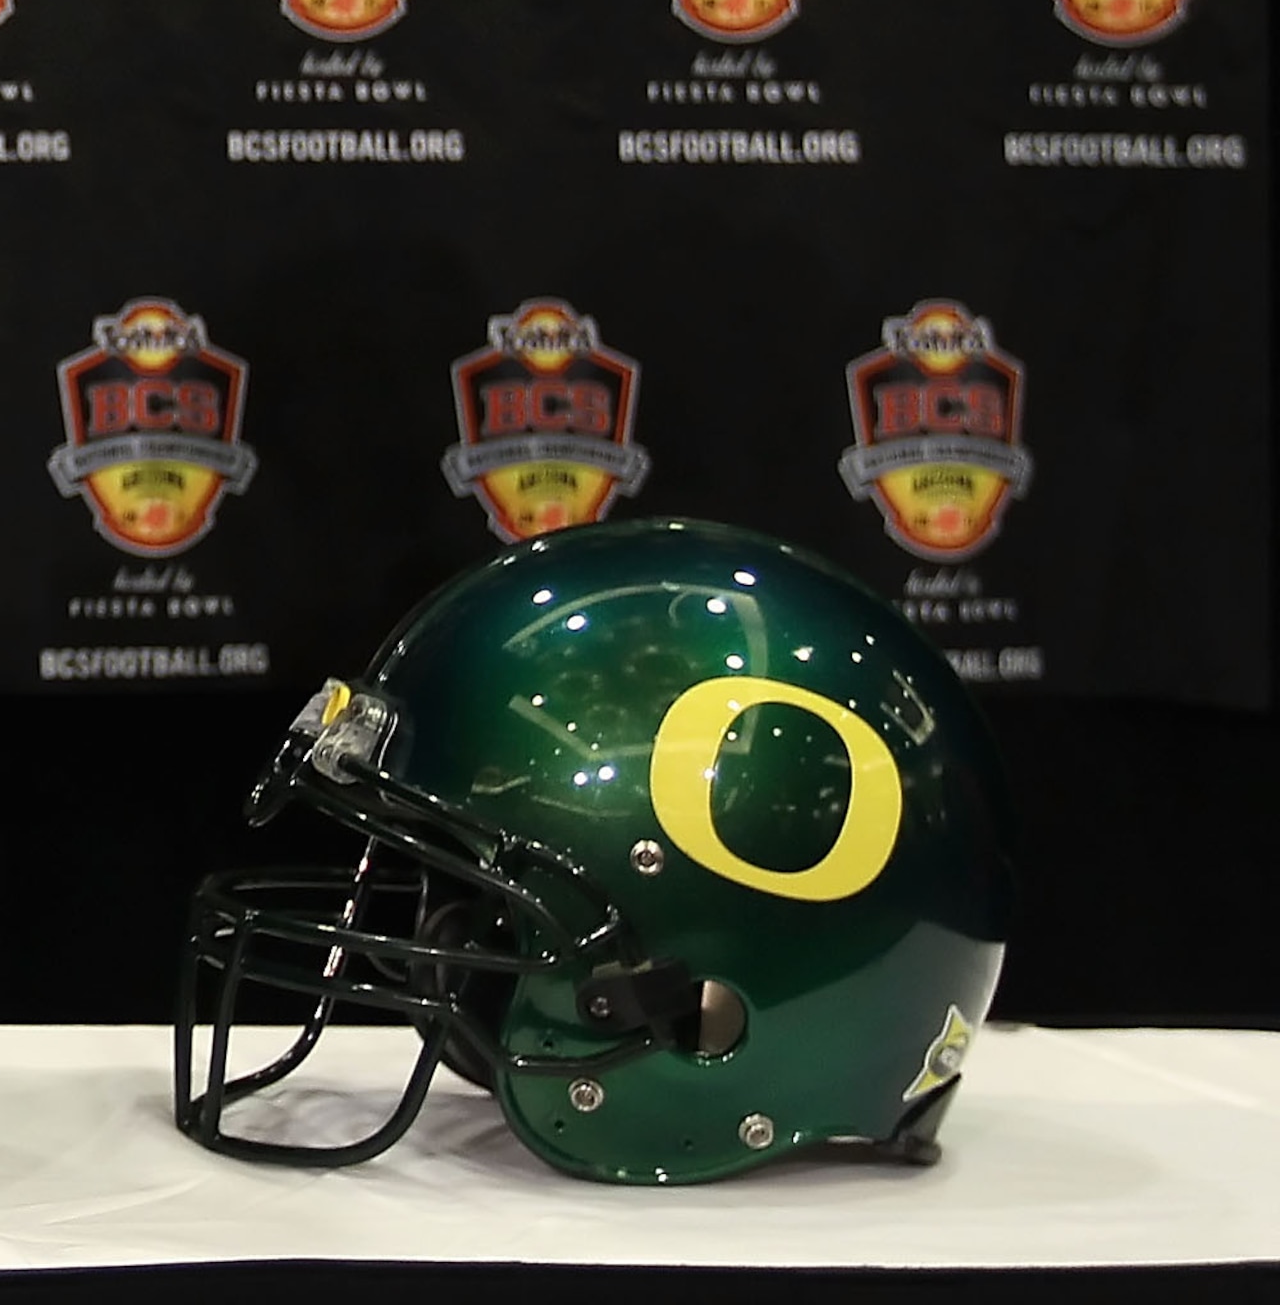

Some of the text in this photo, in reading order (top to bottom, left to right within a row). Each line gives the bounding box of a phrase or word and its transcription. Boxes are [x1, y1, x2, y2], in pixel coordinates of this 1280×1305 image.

[354, 80, 426, 103] BOWL
[226, 129, 466, 162] BCSFOOTBALL.ORG
[618, 129, 861, 164] BCSFOOTBALL.ORG
[1003, 133, 1246, 167] BCSFOOTBALL.ORG
[90, 378, 220, 435] BCS
[485, 378, 611, 435] BCS
[39, 644, 268, 679] BCSFOOTBALL.ORG
[650, 675, 903, 901] O
